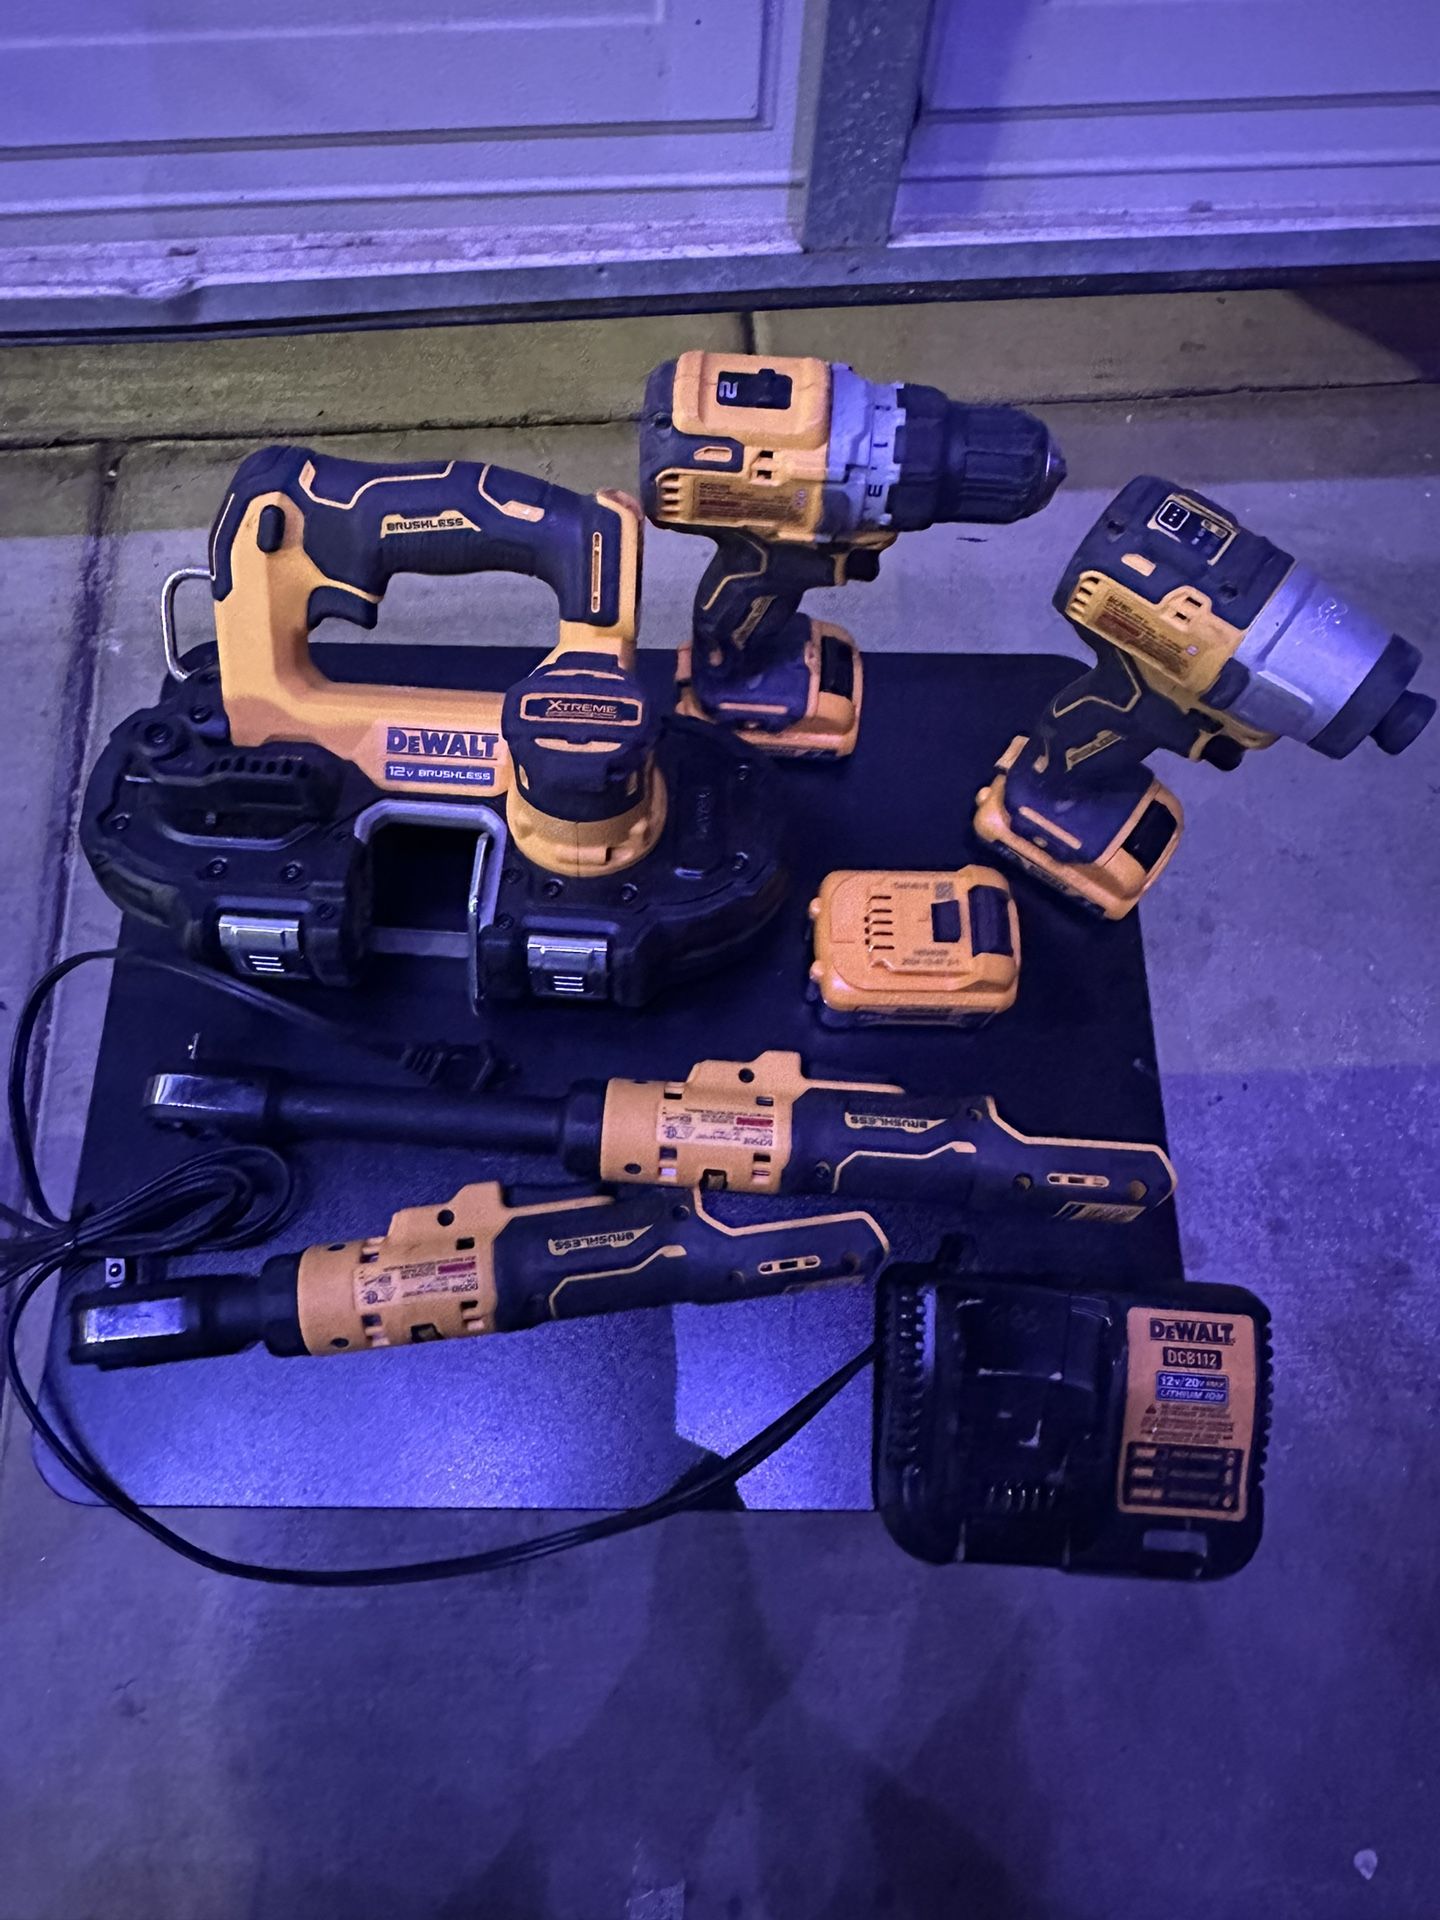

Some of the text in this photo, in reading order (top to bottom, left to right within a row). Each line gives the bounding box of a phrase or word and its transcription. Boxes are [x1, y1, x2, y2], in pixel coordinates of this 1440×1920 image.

[718, 381, 738, 398] 2
[867, 484, 883, 497] 3
[386, 517, 464, 531] BRUSHLESS
[545, 699, 618, 714] XTREME
[418, 769, 491, 781] BRUSHLESS
[850, 1115, 928, 1129] BRUSHLESS
[554, 1231, 635, 1251] BRUSHLESS
[1166, 1349, 1217, 1366] DCB112
[1160, 1389, 1225, 1402] LITHIUM ION
